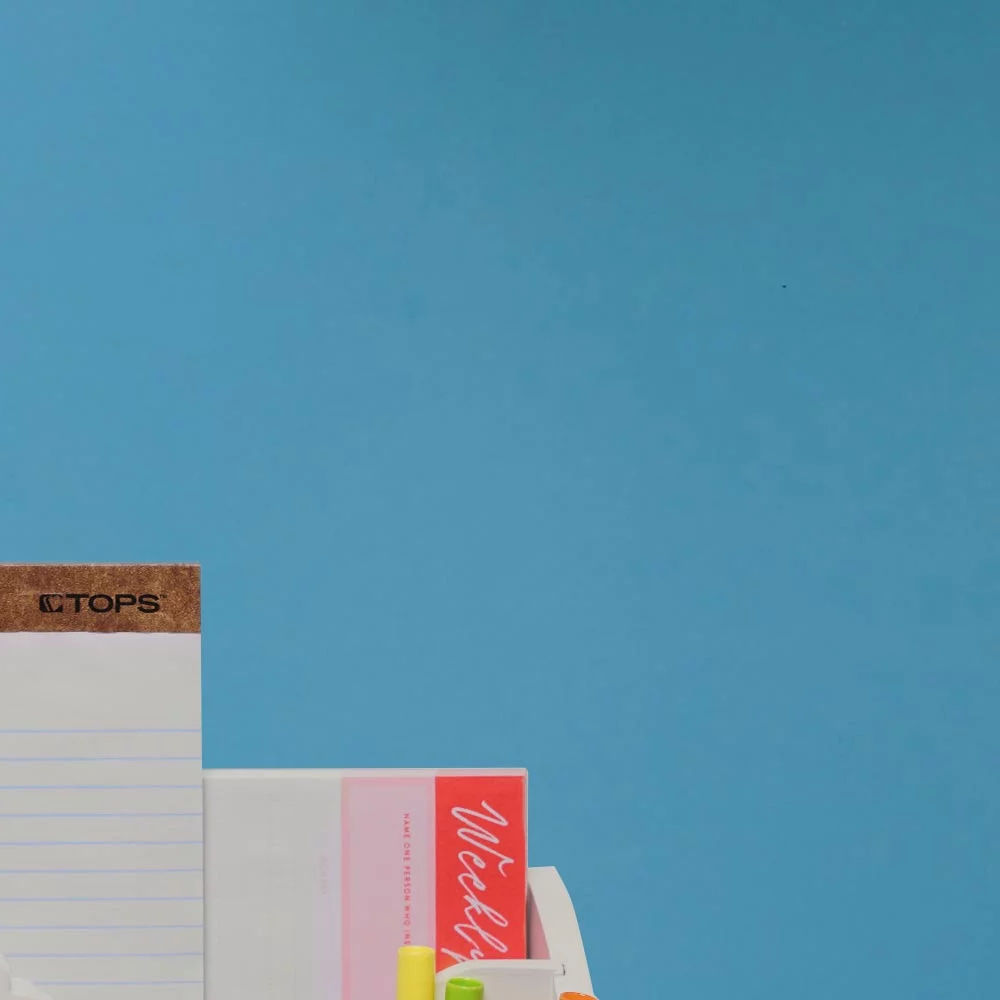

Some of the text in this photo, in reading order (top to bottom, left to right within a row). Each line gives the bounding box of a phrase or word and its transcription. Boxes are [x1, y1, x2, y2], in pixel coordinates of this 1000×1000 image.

[65, 593, 160, 613] TOPS
[403, 813, 411, 839] NAME
[403, 842, 411, 862] ONE
[403, 865, 411, 901] PERSON
[403, 905, 411, 926] WHO
